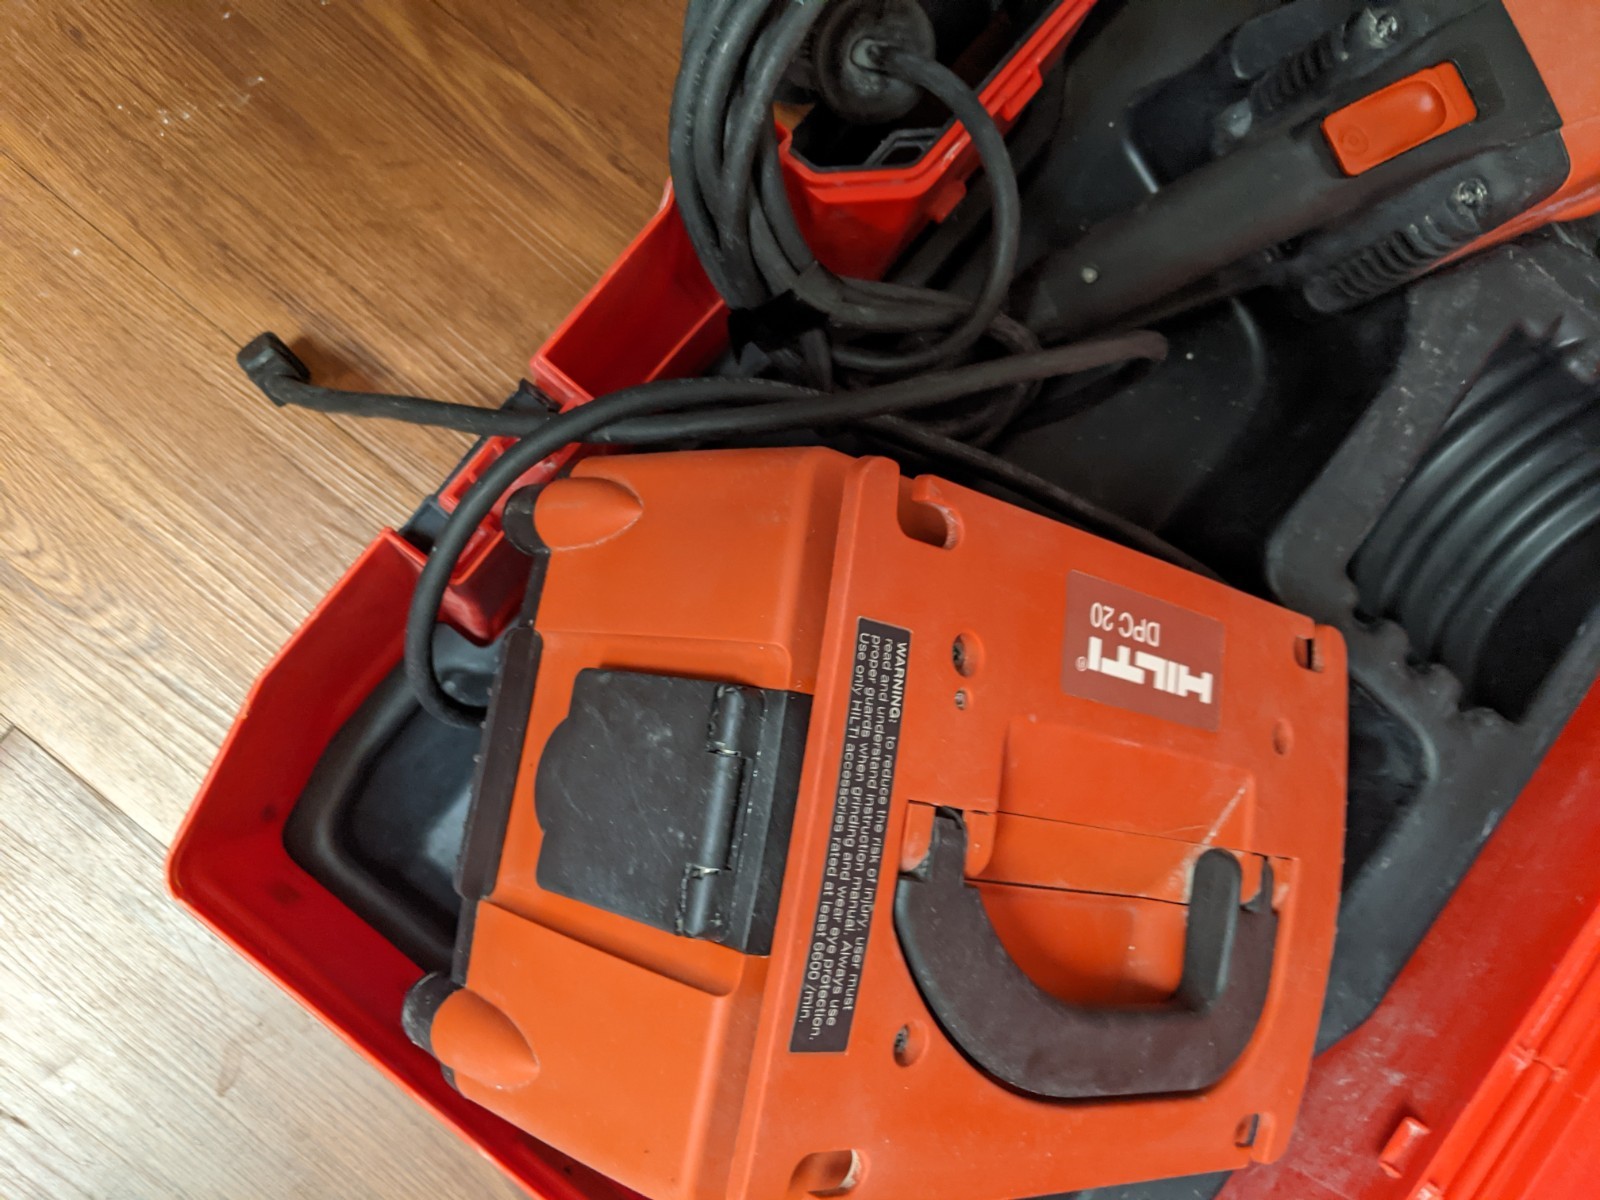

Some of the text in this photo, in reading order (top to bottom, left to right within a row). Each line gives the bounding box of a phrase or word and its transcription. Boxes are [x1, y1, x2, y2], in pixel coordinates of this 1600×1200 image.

[1090, 602, 1160, 647] DPC 20
[857, 630, 870, 661] Use
[867, 633, 880, 684] proper
[882, 637, 894, 671] read
[851, 664, 865, 696] only
[878, 673, 891, 702] and
[847, 698, 862, 739] HILTI
[860, 685, 875, 738] guards
[866, 705, 887, 789] understand
[884, 735, 896, 750] to
[854, 741, 869, 782] when
[877, 754, 895, 805] reduce
[833, 742, 855, 833] accessories
[841, 785, 864, 847] grinding
[853, 793, 876, 872] instruction
[873, 809, 886, 833] the
[825, 836, 842, 877] rated
[838, 851, 854, 881] and
[868, 837, 882, 864] risk
[822, 881, 836, 896] at
[865, 868, 877, 883] of
[815, 900, 833, 937] least
[831, 885, 847, 922] wear
[824, 926, 840, 954] eye
[850, 936, 864, 968] user
[807, 941, 825, 980] 6600
[830, 940, 853, 994] Always
[842, 973, 859, 1011] must
[825, 999, 839, 1026] use
